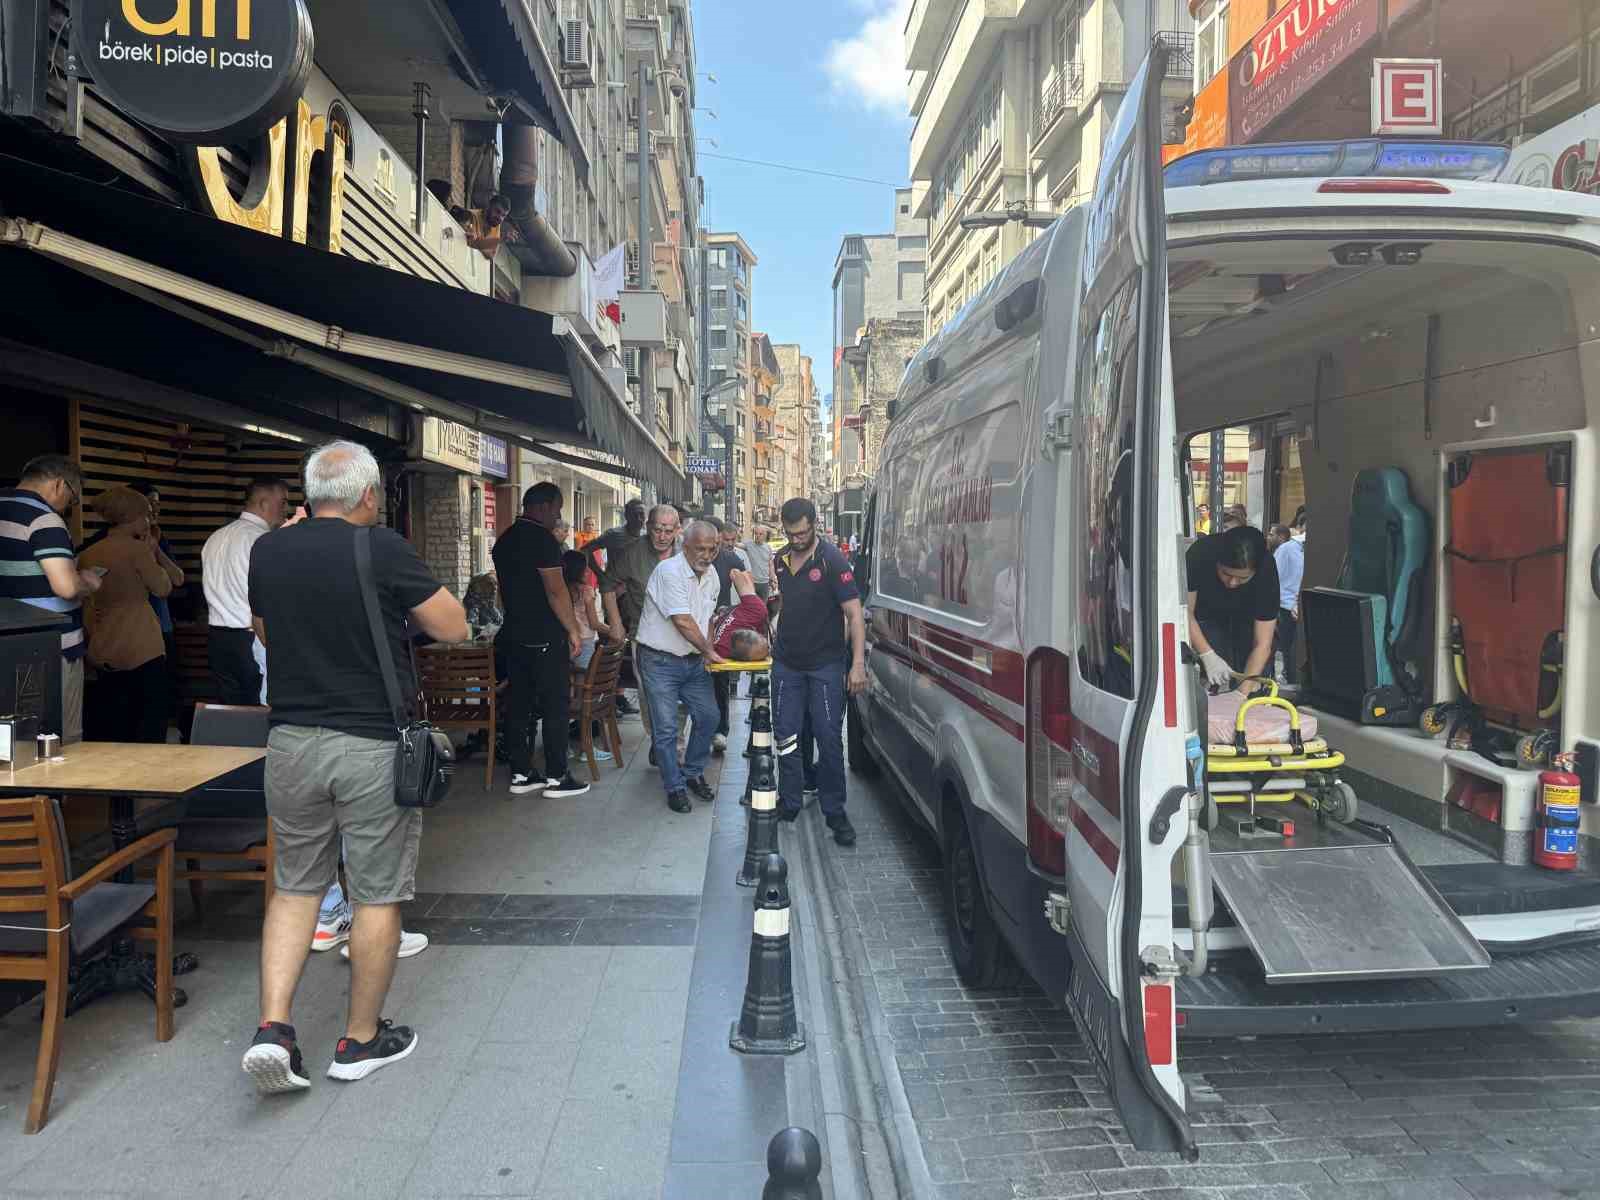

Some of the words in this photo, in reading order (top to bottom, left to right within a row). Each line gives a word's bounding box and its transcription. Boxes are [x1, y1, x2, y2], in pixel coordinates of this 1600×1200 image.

[100, 41, 153, 62] börek
[164, 44, 209, 67] pide
[219, 50, 273, 70] pasta
[1391, 73, 1427, 118] E
